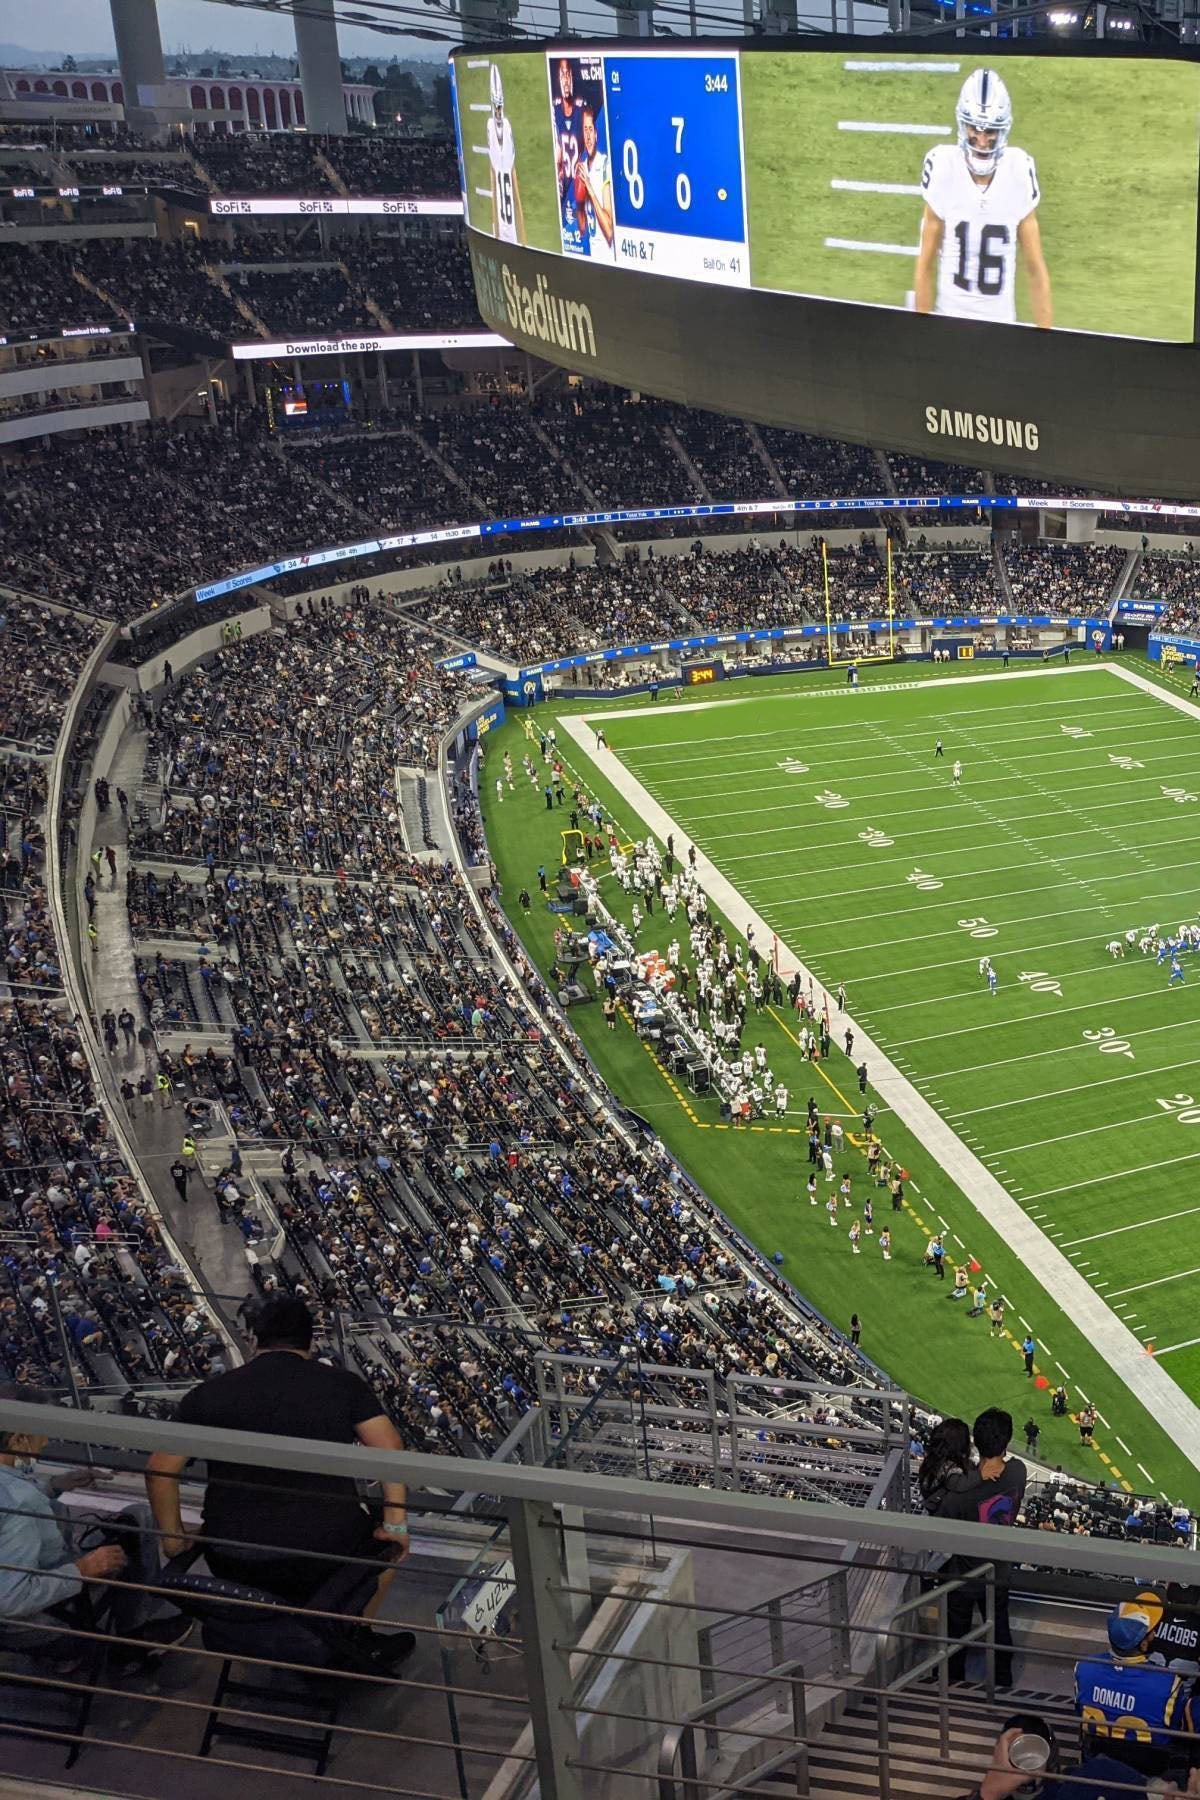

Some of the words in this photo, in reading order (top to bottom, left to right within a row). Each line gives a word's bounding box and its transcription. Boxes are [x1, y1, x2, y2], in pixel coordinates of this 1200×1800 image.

[704, 74, 728, 92] 3:44
[671, 117, 684, 154] 7
[676, 172, 691, 211] 0
[215, 202, 239, 213] SoFi
[299, 202, 322, 213] SoFi
[383, 202, 406, 213] SoFi
[621, 238, 637, 258] 4th
[639, 245, 647, 260] &
[648, 243, 655, 261] 7
[729, 257, 741, 273] 41
[953, 221, 1010, 296] 16
[502, 263, 597, 357] Stadium
[286, 343, 339, 354] Download
[341, 341, 358, 351] the
[359, 341, 382, 353] app.
[925, 406, 1039, 451] SAMSUNG
[1027, 499, 1049, 507] Week
[287, 560, 297, 568] 34
[1133, 603, 1155, 611] RAMS
[691, 669, 713, 683] 3:44
[1062, 727, 1094, 739] 10
[776, 759, 810, 774] 10
[1110, 756, 1145, 769] 20
[814, 793, 850, 808] 20
[1162, 788, 1198, 803] 30
[858, 830, 894, 848] 30
[906, 872, 944, 890] 40
[957, 917, 999, 938] 50
[1017, 970, 1061, 992] 40
[1082, 1027, 1131, 1053] 30
[1153, 1621, 1199, 1648] JACOBS
[1092, 1685, 1136, 1712] DONALD
